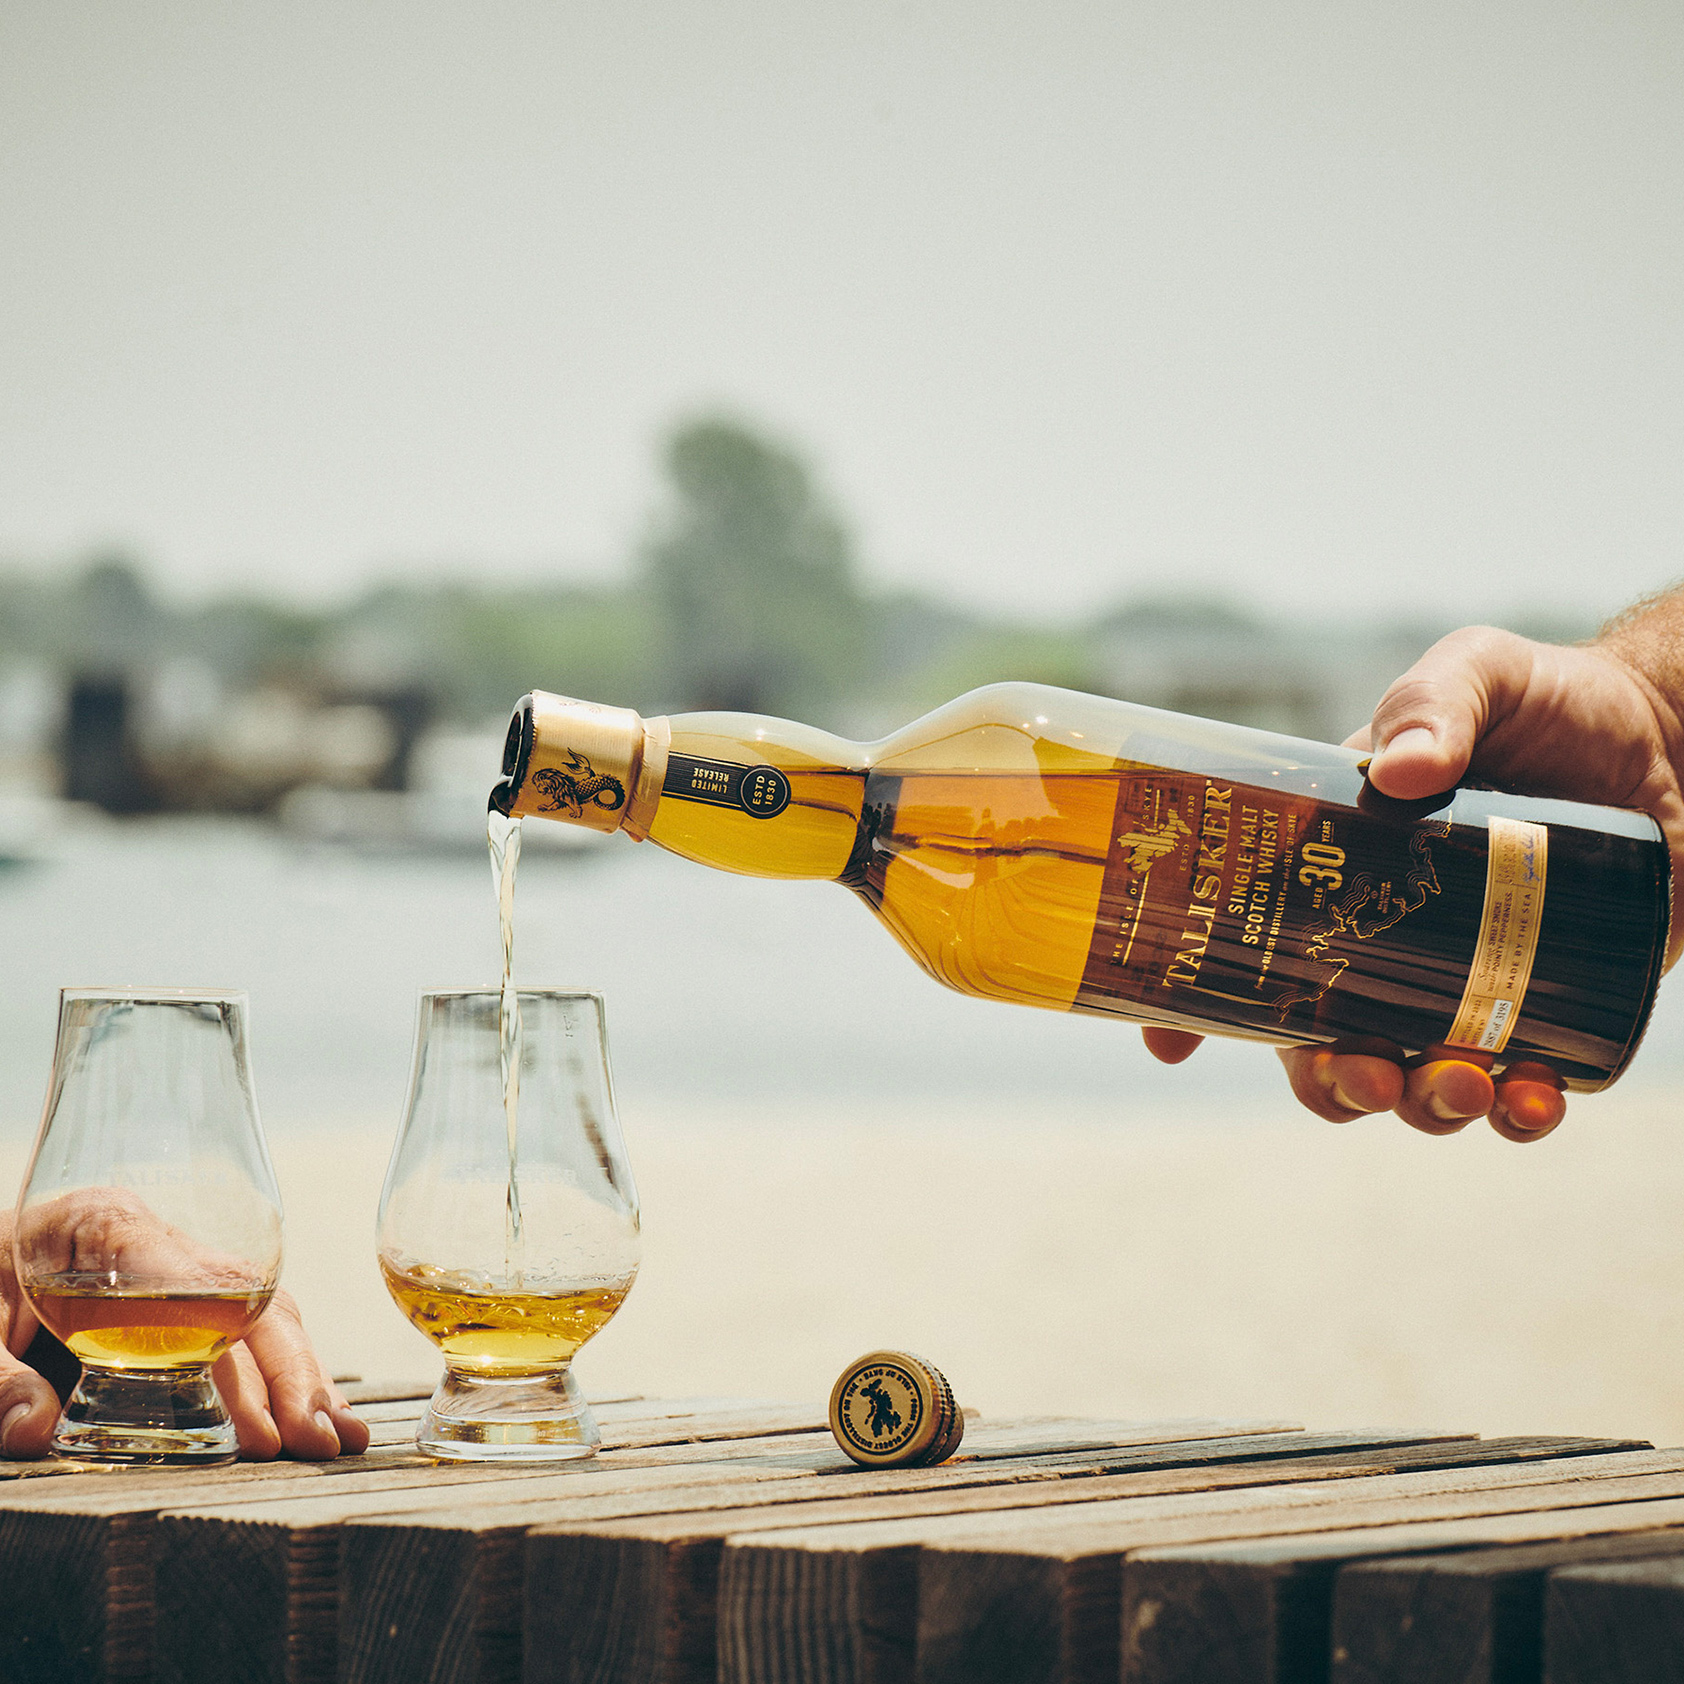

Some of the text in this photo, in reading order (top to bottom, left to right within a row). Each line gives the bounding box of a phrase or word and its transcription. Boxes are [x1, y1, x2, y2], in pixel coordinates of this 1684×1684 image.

[691, 778, 728, 795] LIMITED
[693, 767, 730, 783] RELEASE
[752, 775, 765, 806] ESTD
[764, 779, 777, 806] 1830
[1187, 794, 1196, 818] 1830
[1288, 813, 1297, 834] SKYE
[1321, 819, 1332, 843] YEARS
[1119, 905, 1134, 935] ISLE
[1130, 878, 1139, 896] OF
[1142, 785, 1153, 820] SKYE
[1179, 844, 1190, 872] ESTD
[1228, 804, 1259, 915] SINGLE MALT
[1283, 849, 1294, 867] ISLE
[1298, 842, 1346, 891] 30
[1241, 808, 1279, 945] SCOTCH WHISKY
[1312, 887, 1324, 910] AGED
[1521, 893, 1532, 914] SEA
[1269, 891, 1287, 936] DISTILLERY
[1518, 919, 1528, 938] THE
[1261, 936, 1277, 964] OLDEST
[1514, 943, 1523, 957] BY
[1506, 961, 1520, 990] MADE
[1492, 1021, 1502, 1032] of
